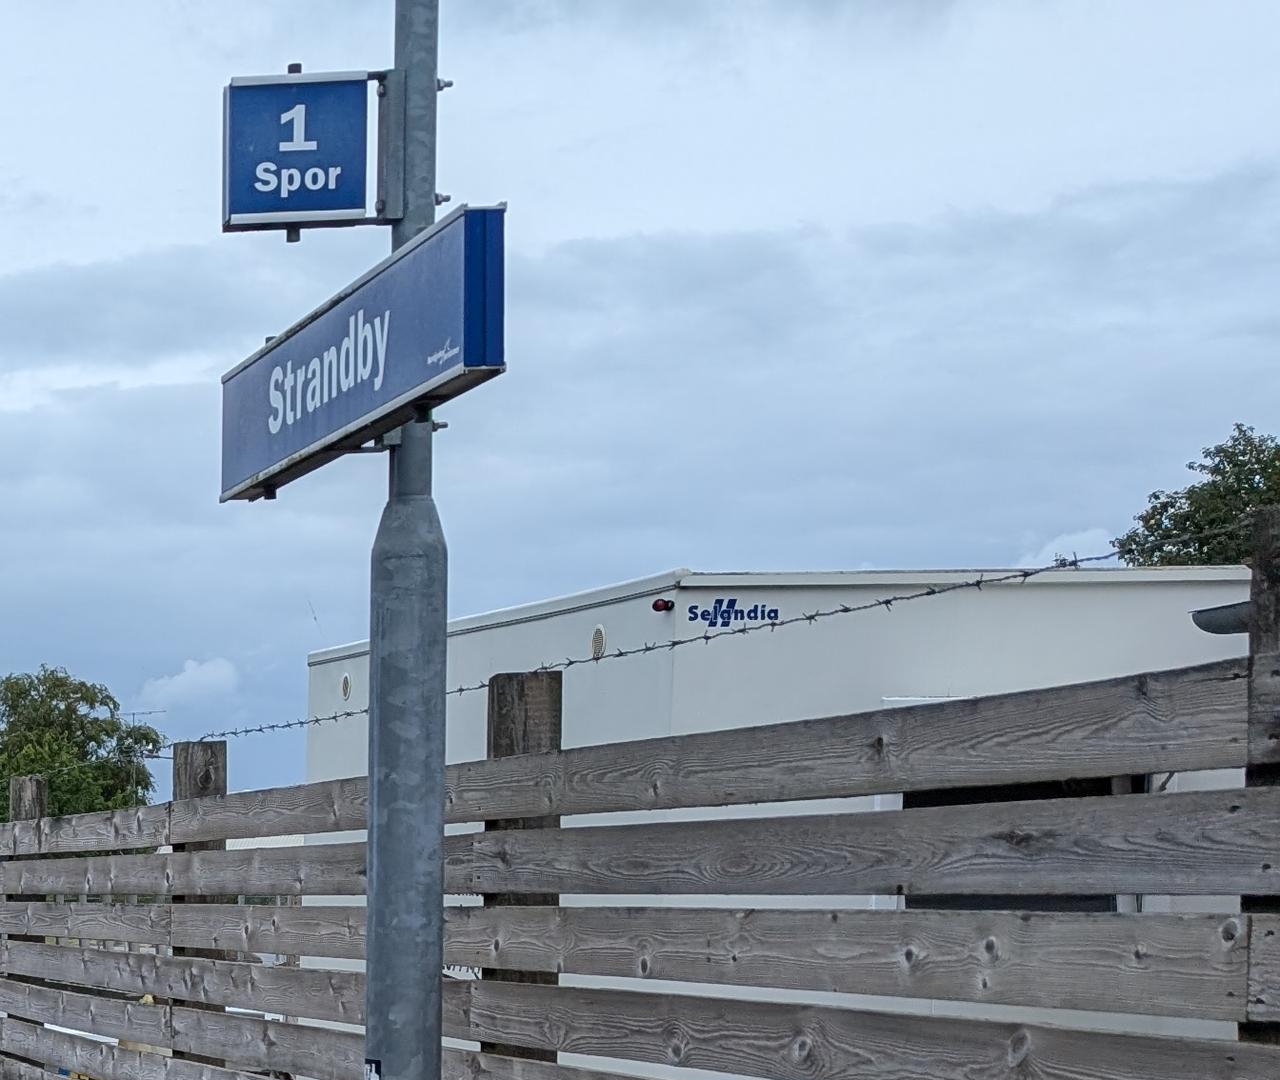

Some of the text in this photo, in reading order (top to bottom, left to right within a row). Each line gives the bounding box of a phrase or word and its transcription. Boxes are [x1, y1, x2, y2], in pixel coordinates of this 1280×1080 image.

[278, 104, 319, 153] 1
[253, 161, 342, 197] Spor
[267, 307, 392, 435] Strandby
[688, 603, 779, 623] Selandia
